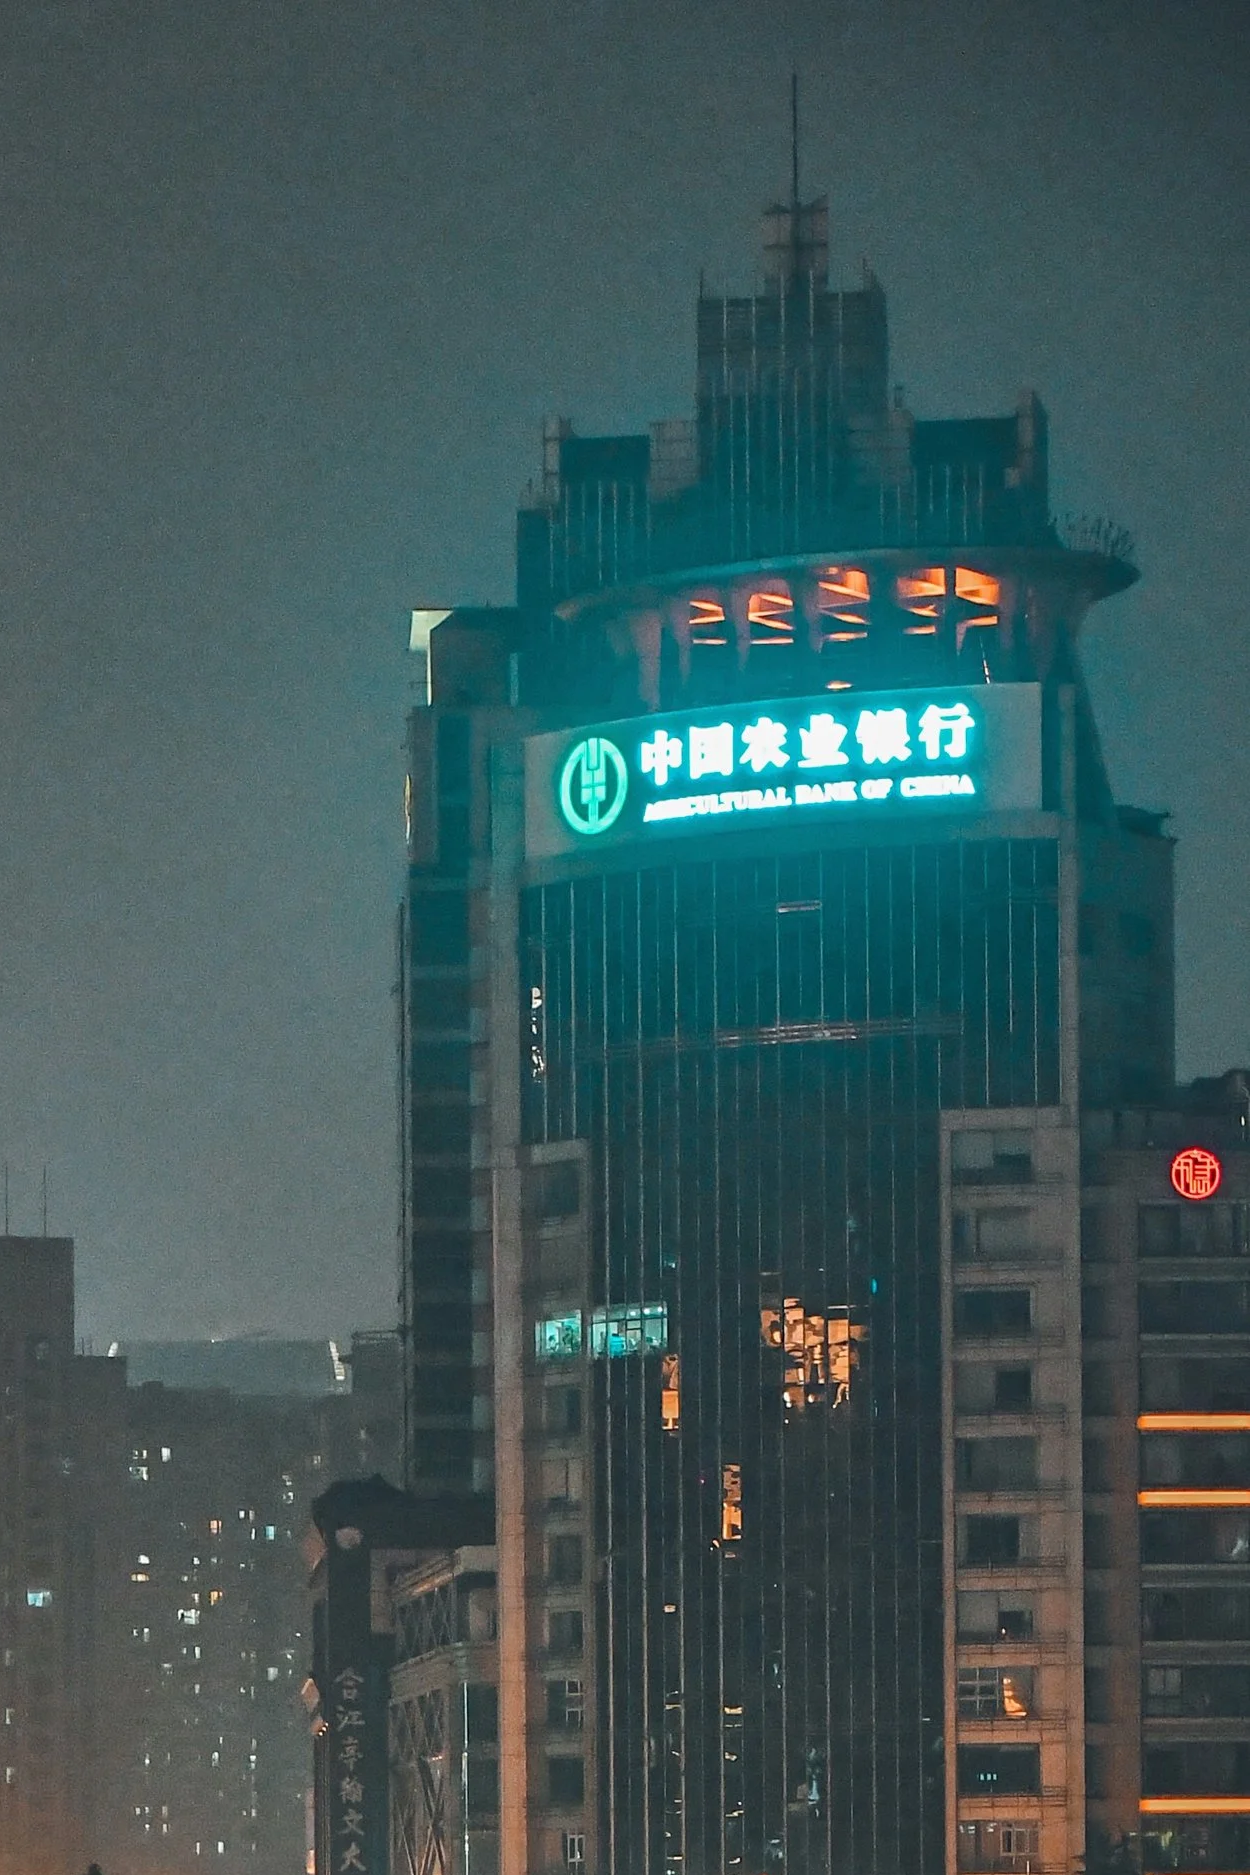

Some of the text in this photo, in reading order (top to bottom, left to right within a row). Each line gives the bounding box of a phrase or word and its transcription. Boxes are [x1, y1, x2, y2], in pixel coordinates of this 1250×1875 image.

[641, 702, 975, 786] 中国农业银行
[795, 781, 857, 805] BANK
[861, 778, 893, 799] OF
[900, 774, 975, 797] CHINA
